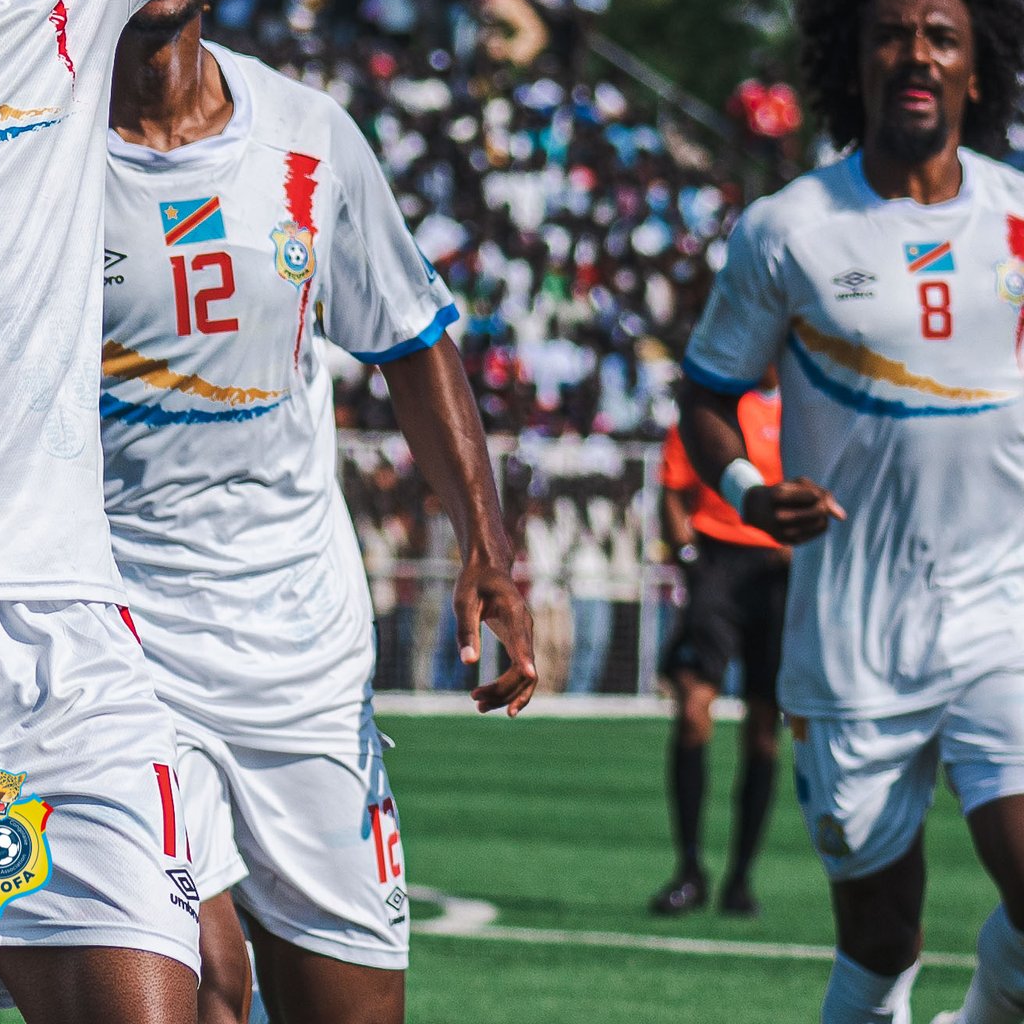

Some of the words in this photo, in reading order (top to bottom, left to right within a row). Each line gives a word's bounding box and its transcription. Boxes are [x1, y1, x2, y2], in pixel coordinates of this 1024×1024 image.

[170, 251, 239, 336] 12
[919, 281, 953, 340] 8
[153, 763, 192, 864] 1
